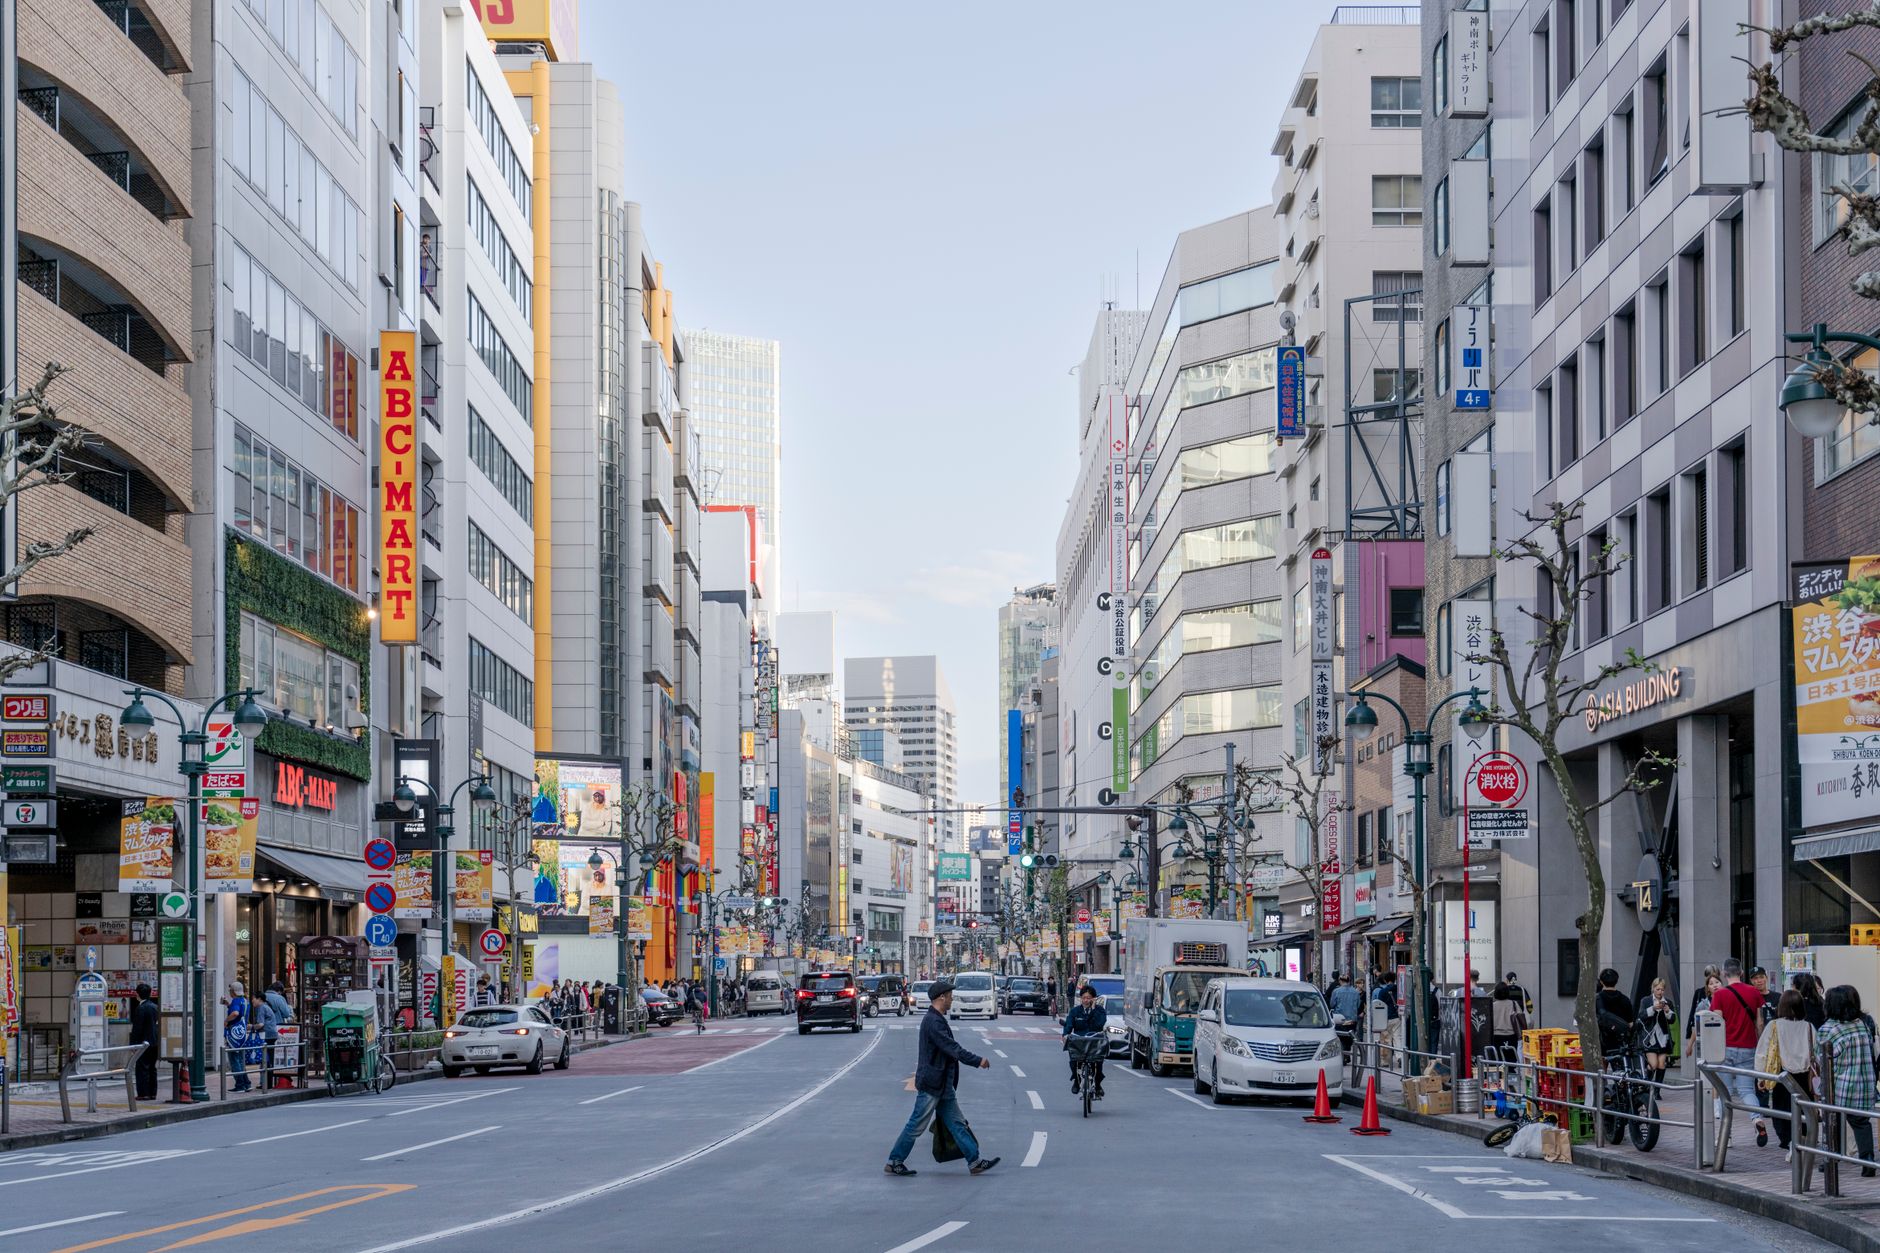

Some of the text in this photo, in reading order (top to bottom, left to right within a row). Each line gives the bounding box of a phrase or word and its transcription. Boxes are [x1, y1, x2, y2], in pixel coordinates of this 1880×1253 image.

[1470, 16, 1479, 72] 神南ポート
[1461, 53, 1470, 106] ギャラリー
[1464, 392, 1480, 405] 4F
[384, 351, 412, 620] ABC-MART
[1114, 464, 1124, 522] 日本生命
[1800, 568, 1842, 588] チンチャ
[1800, 580, 1842, 599] おいしい!
[1315, 565, 1328, 654] 神南大井ビル
[1115, 599, 1125, 656] 渋谷公証役場
[1802, 606, 1863, 644] 渋谷
[1598, 666, 1680, 723] ASIA BUILDING
[1808, 674, 1880, 699] 日本1号店
[7, 700, 45, 717] つり具
[6, 732, 46, 742] お売り下さい
[206, 775, 240, 787] たばこ
[276, 762, 337, 811] ABC-MART
[1480, 773, 1516, 790] 消火栓
[1817, 777, 1847, 796] KATORIYA
[125, 820, 152, 836] 渋谷
[124, 852, 158, 862] 日本1号店
[372, 924, 383, 943] P
[381, 934, 390, 943] 40
[524, 951, 532, 977] GYG!
[455, 970, 466, 1012] KIRIN
